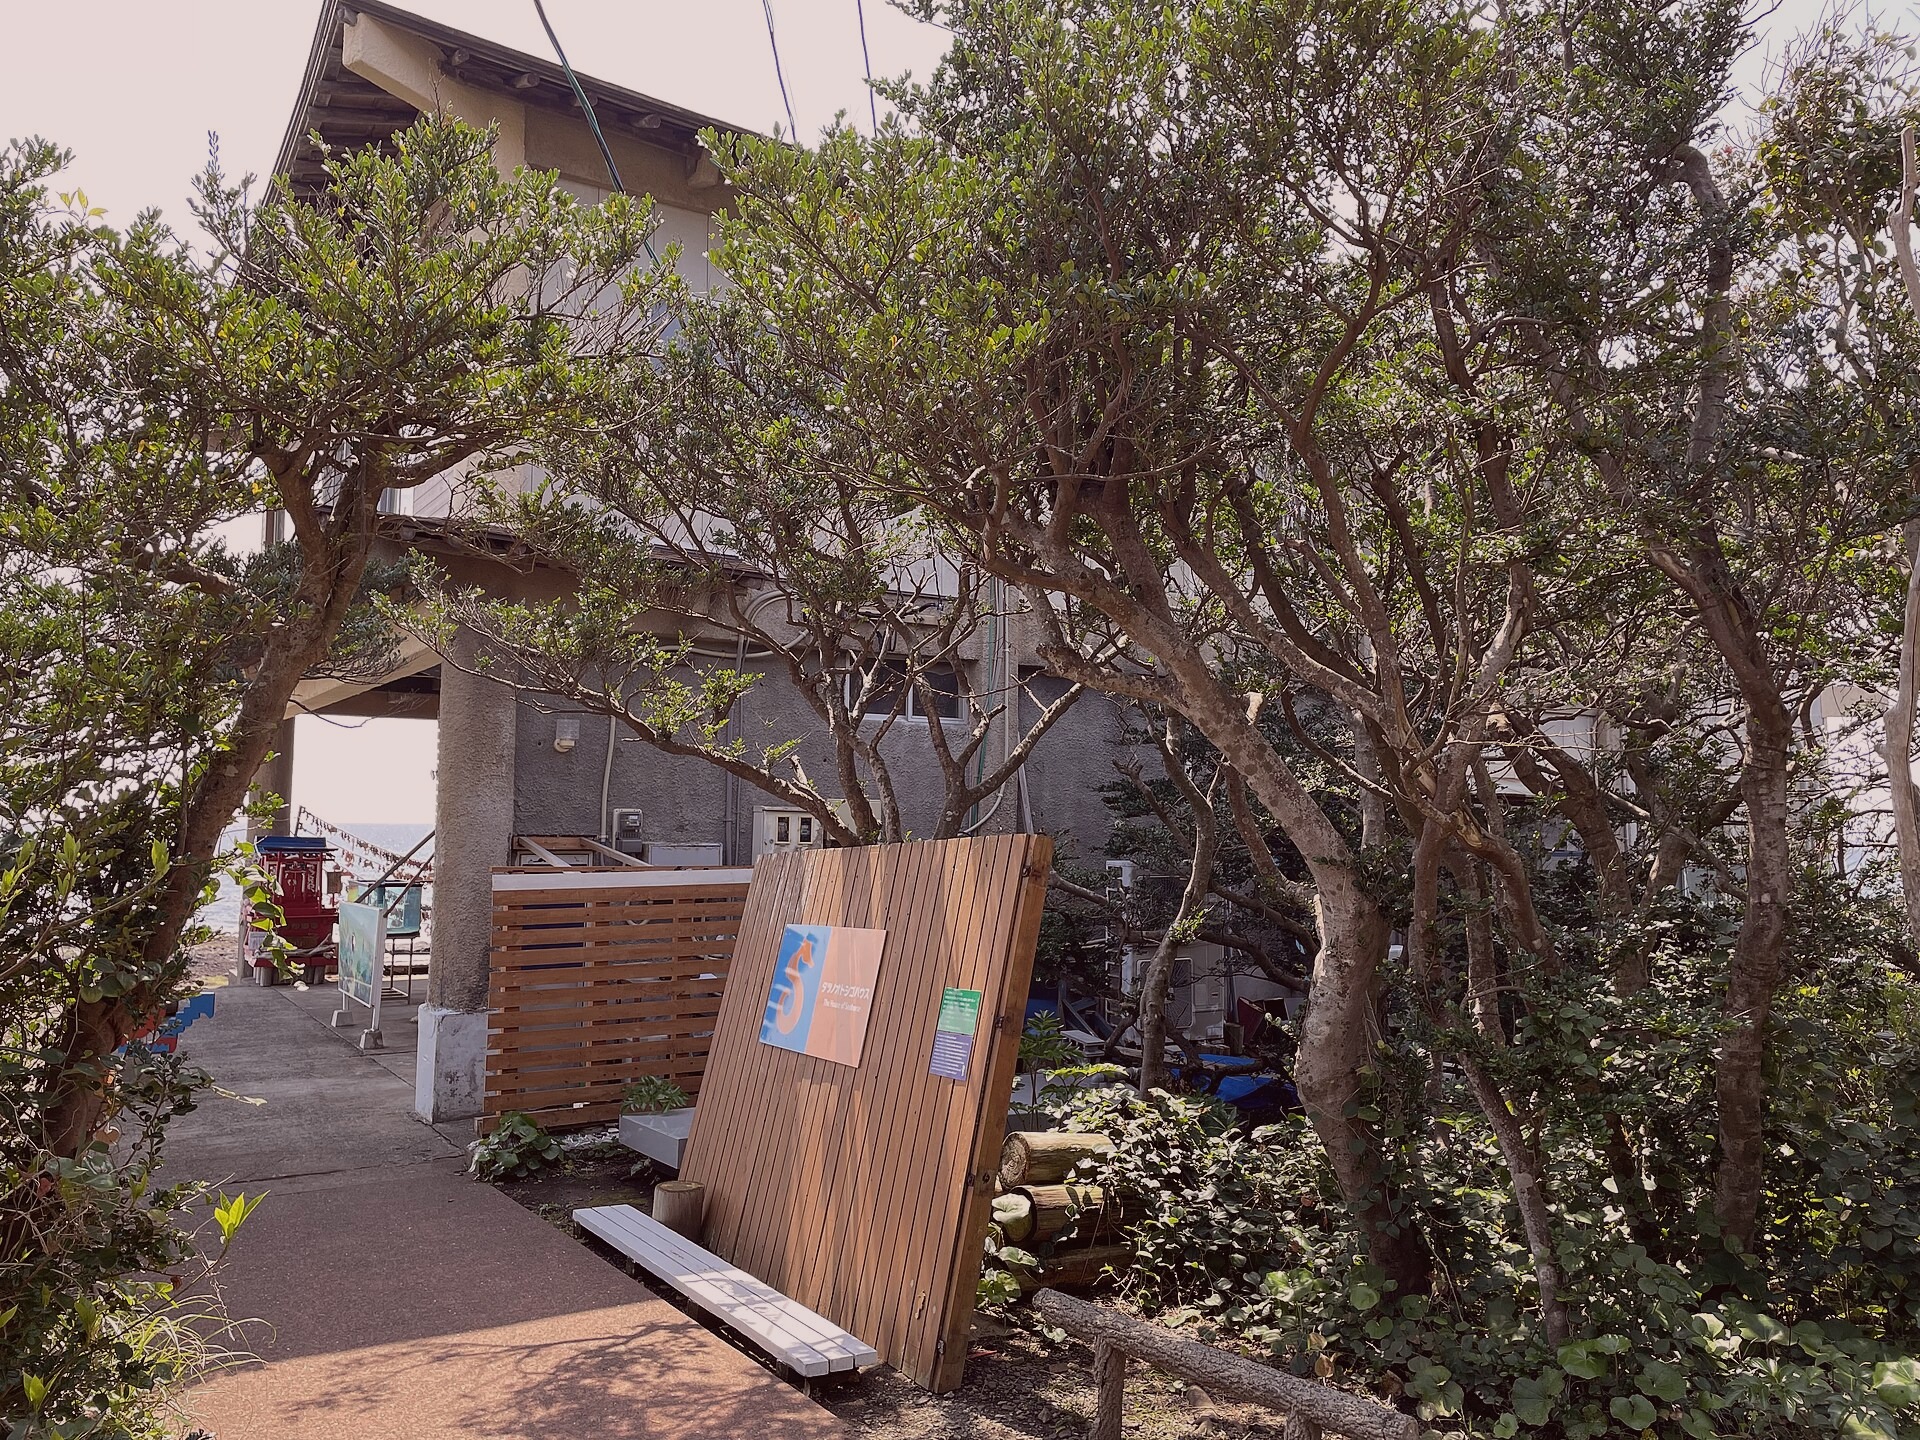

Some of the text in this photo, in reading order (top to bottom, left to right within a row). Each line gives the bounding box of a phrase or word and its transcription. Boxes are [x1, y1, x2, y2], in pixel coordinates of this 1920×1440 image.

[821, 982, 870, 999] タツノオトシゴハウス
